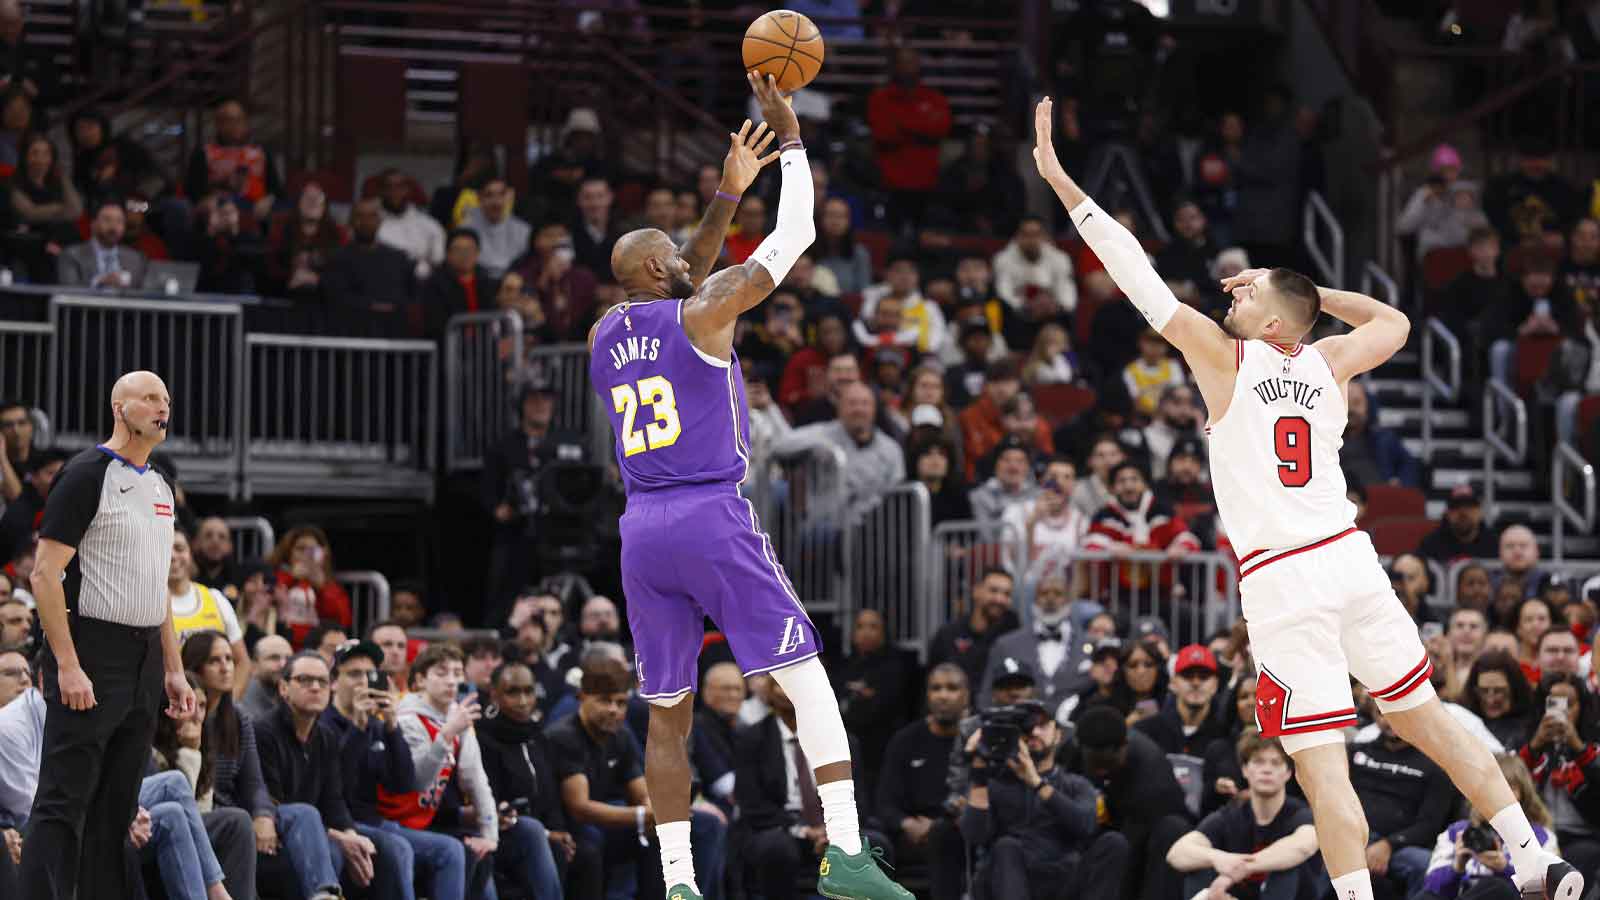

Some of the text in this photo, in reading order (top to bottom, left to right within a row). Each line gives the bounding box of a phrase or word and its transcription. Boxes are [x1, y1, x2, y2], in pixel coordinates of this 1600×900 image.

[609, 336, 661, 370] JAMES
[609, 375, 682, 458] 23
[1273, 416, 1312, 487] 9
